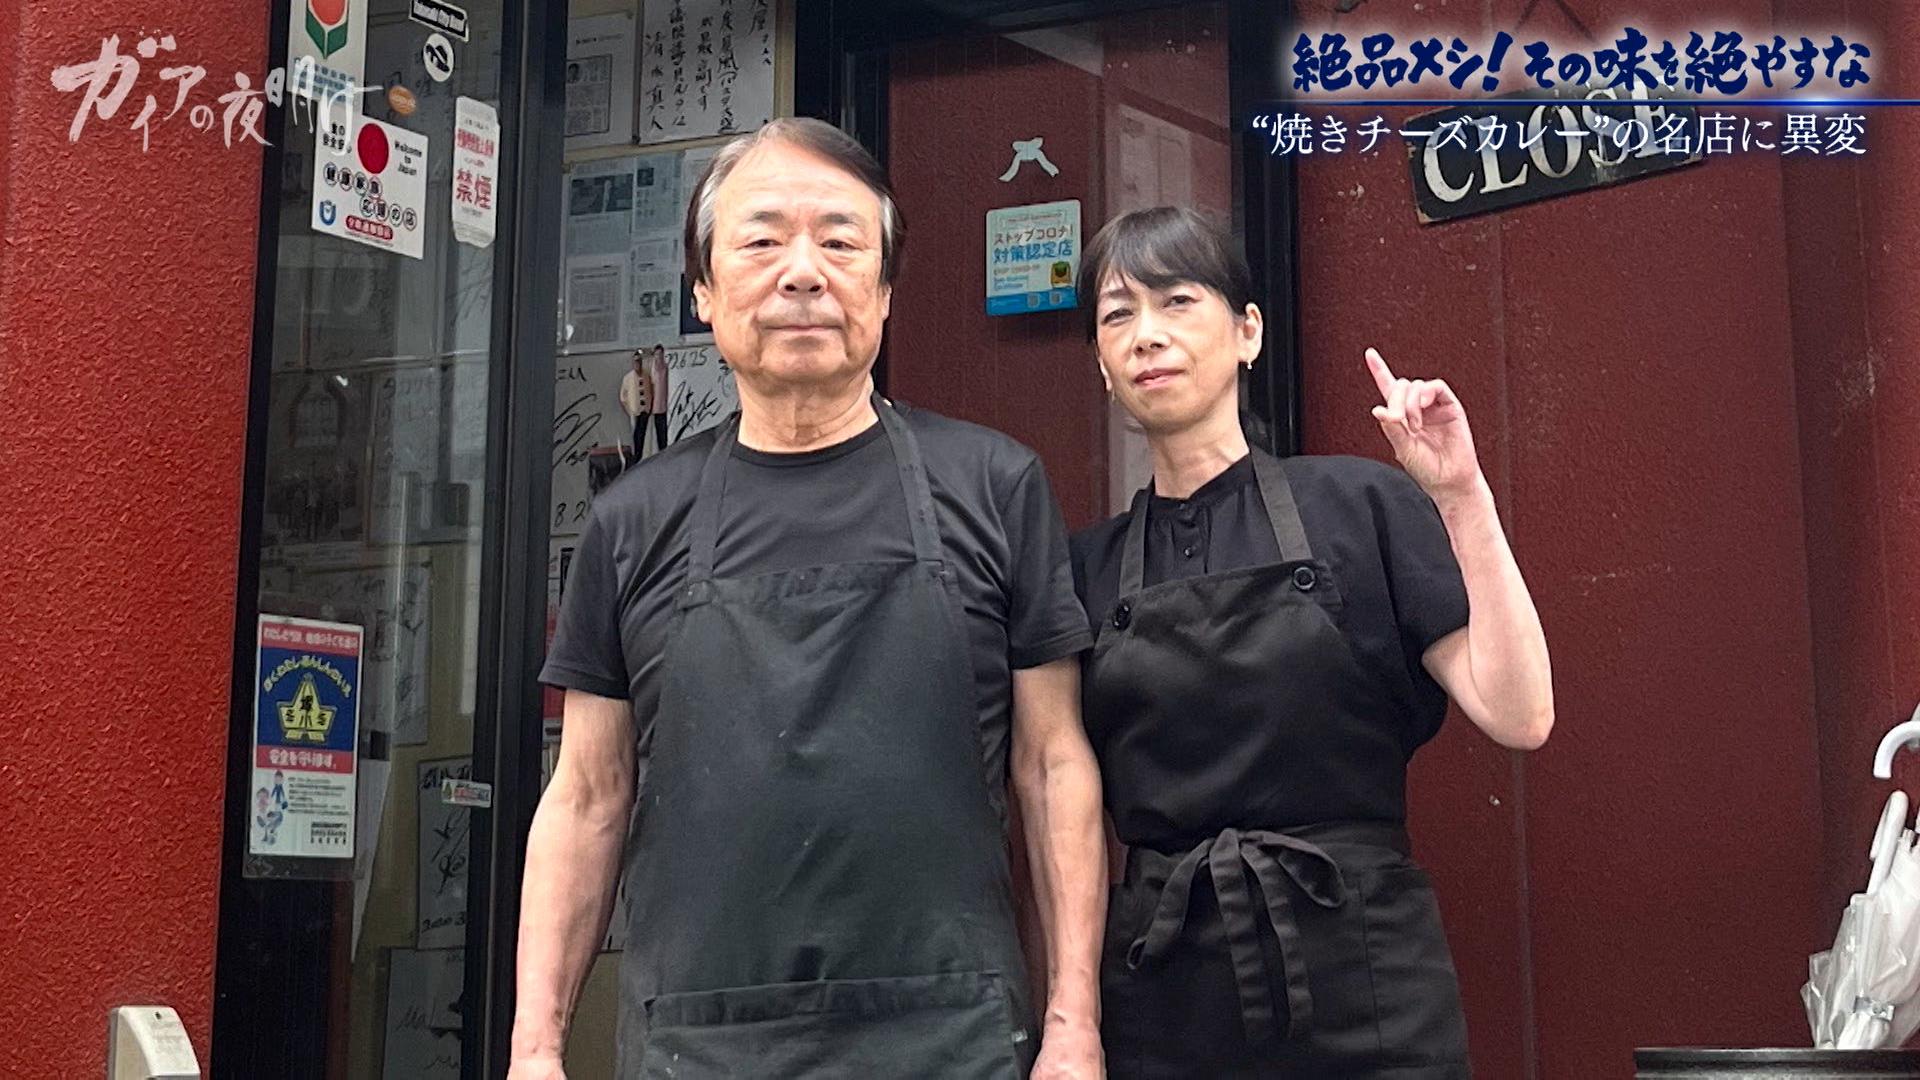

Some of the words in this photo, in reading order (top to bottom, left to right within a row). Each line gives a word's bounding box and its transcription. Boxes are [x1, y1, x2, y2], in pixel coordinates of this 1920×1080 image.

[456, 168, 492, 210] 禁煙
[993, 224, 1073, 245] ストップコロナ!
[993, 240, 1073, 263] 対策認定店
